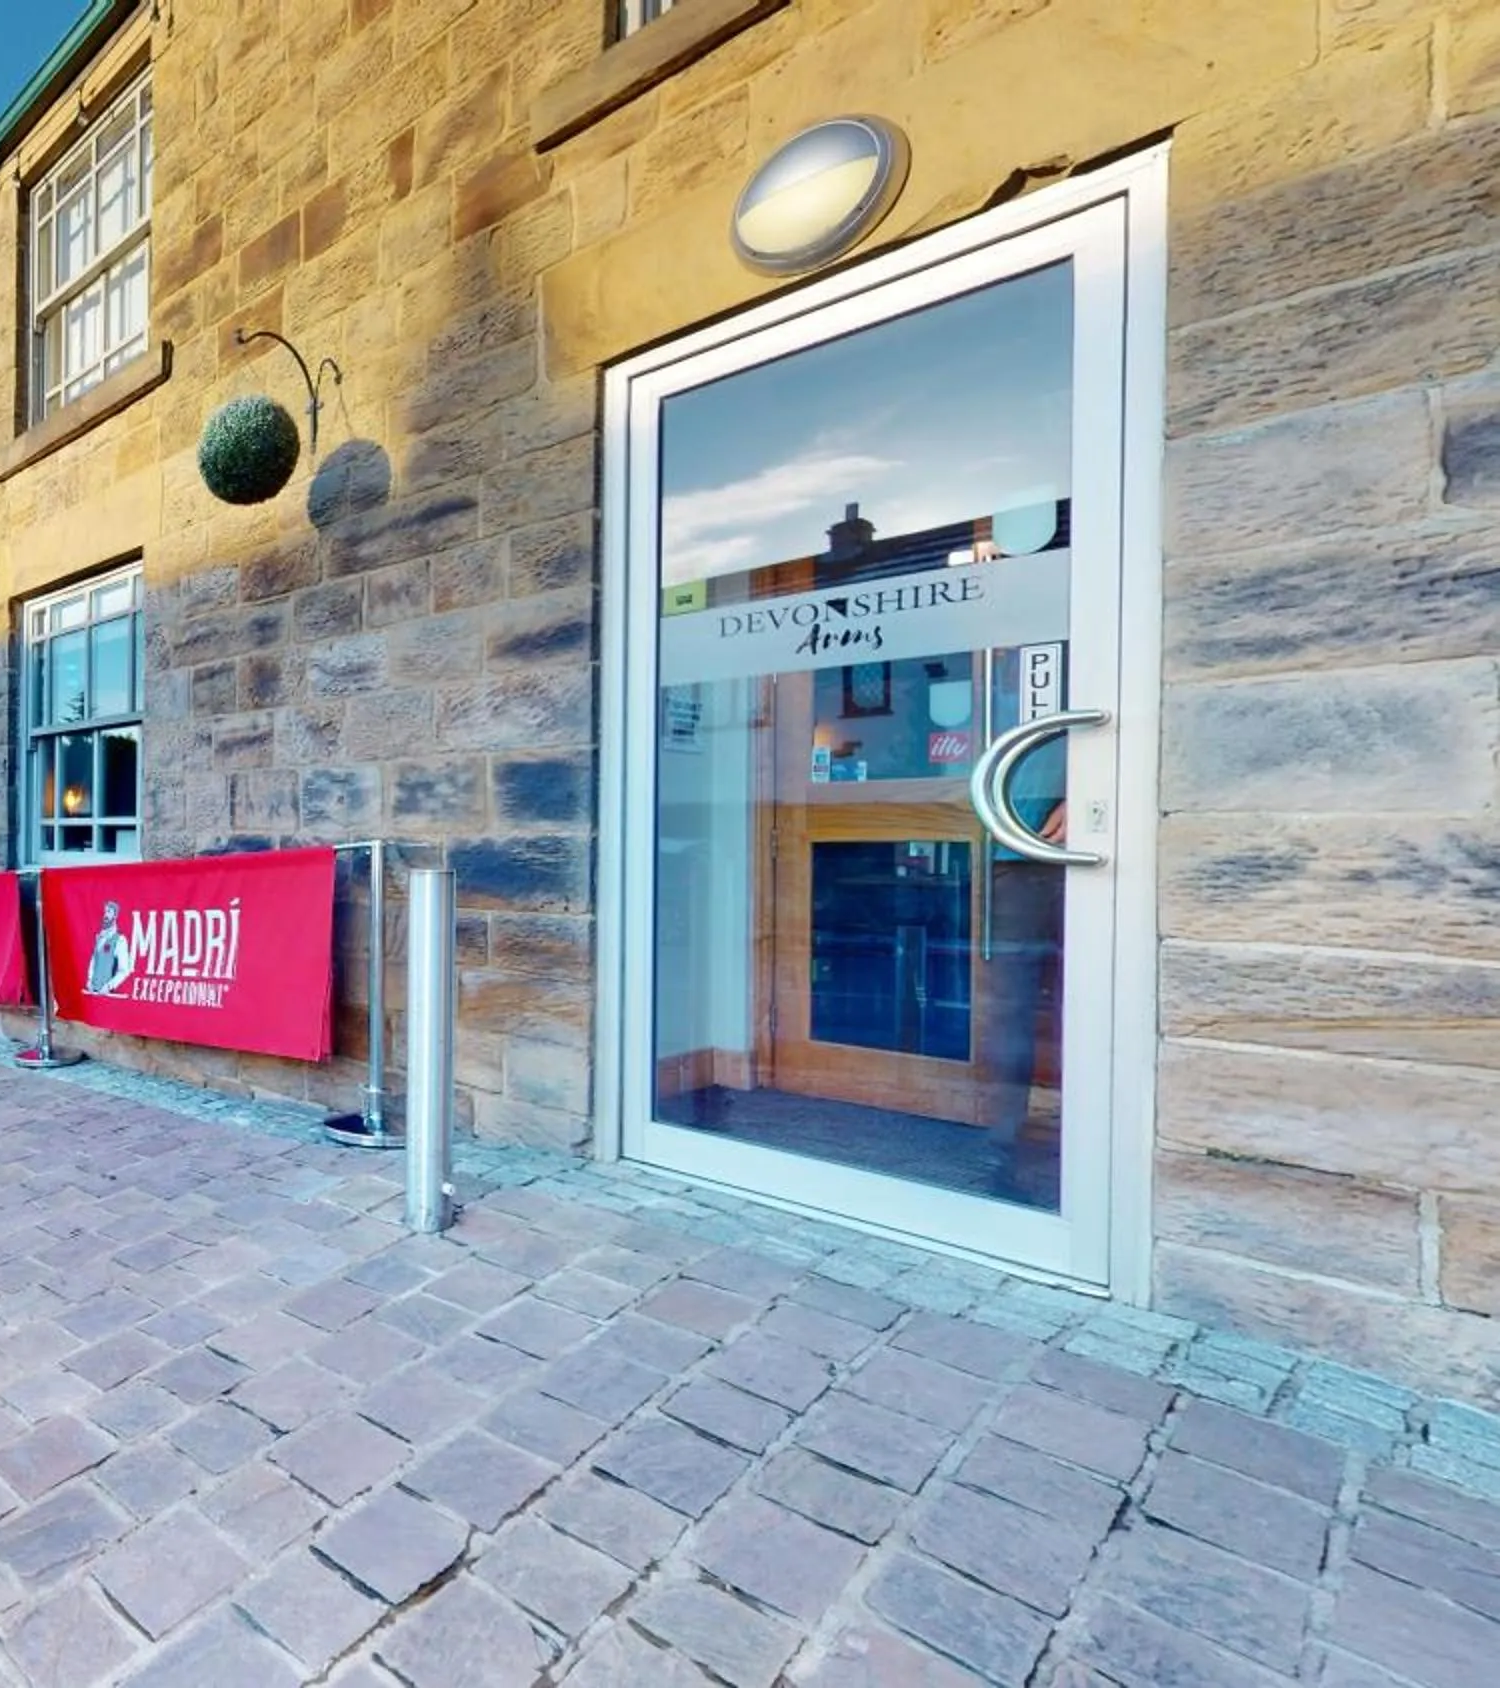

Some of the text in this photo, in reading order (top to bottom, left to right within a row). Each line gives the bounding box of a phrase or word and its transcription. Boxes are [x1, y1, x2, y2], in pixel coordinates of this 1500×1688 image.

[718, 575, 985, 638] DEVONSHIRE
[795, 623, 883, 655] Arms
[930, 735, 969, 763] illy
[130, 897, 241, 979] MADRÍ
[131, 977, 224, 1009] EXCEPCIONAL
